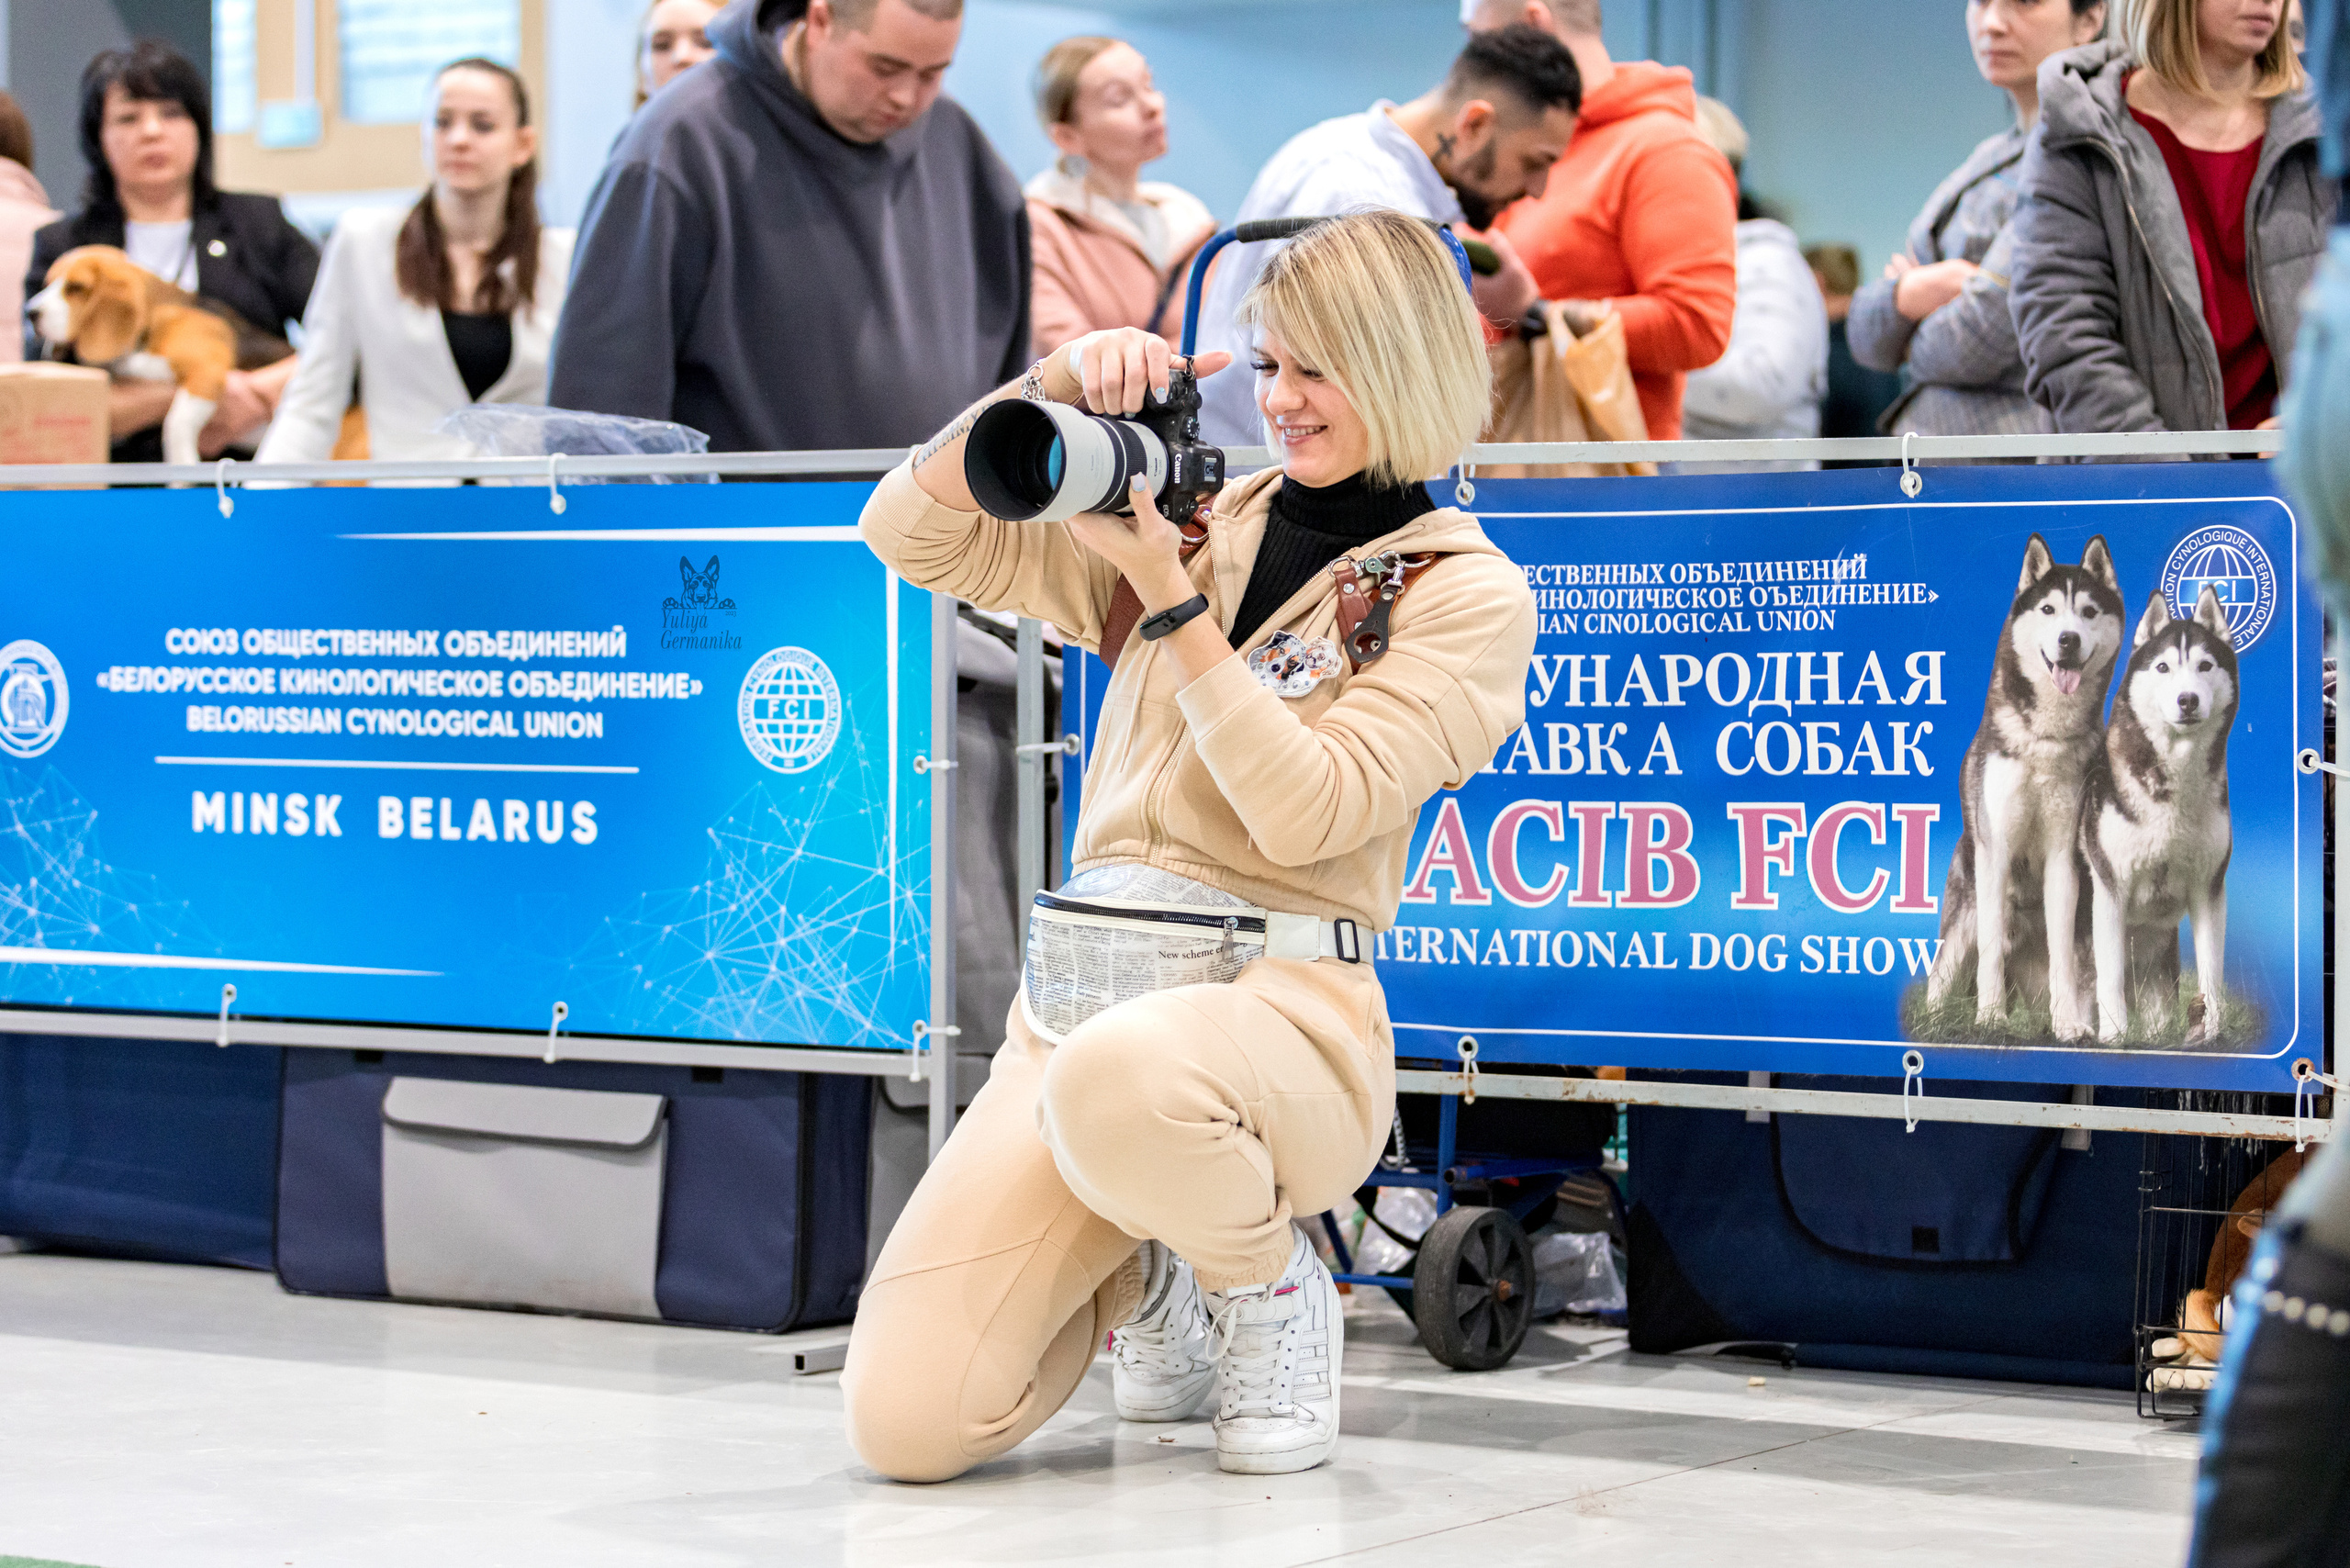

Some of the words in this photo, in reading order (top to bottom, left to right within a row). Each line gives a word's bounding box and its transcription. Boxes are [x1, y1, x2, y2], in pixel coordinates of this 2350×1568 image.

[1174, 453, 1183, 484] Canon
[1162, 504, 1170, 518] EOS
[1520, 564, 1665, 586] ЕСТВЕННЫХ
[1670, 553, 1867, 587] ОБЪЕДИНЕНИЙ
[1531, 588, 1743, 610] ИНОЛОГИЧЕСКОЕ
[1749, 582, 1940, 610] ОЪЕДИНЕНИЕ»
[2172, 531, 2248, 571] CYNOLOGIQUE
[2233, 544, 2272, 647] INTERNATIONALE
[1539, 613, 1579, 634] IAN
[1583, 611, 1751, 634] CINOLOGICAL
[1755, 609, 1837, 632] UNION
[165, 628, 239, 655] СОЮЗ
[241, 628, 441, 659] ОБЩЕСТВЕННЫХ
[443, 624, 627, 661] ОБЪЕДИНЕНИЙ
[96, 666, 276, 694] «БЕЛОРУССКОЕ
[279, 667, 504, 698] КИНОЛОГИЧЕСКОЕ
[507, 670, 703, 701] ОБЪЕДИНЕНИЕ»
[1529, 650, 1947, 717] УНАРОДНАЯ
[186, 705, 341, 734] BELORUSSIAN
[345, 707, 520, 737] CYNOLOGICAL
[523, 710, 603, 738] UNION
[767, 699, 811, 720] FCI
[1478, 720, 1683, 776] АВКА
[1715, 720, 1935, 777] СОБАК
[191, 790, 343, 837] MINSK
[377, 795, 599, 846] BELARUS
[1401, 797, 1701, 909] ACIB
[1727, 801, 1941, 914] FCI
[1158, 950, 1179, 959] New
[1181, 948, 1214, 959] scheme
[1376, 925, 1677, 969] TERNATIONAL
[1688, 933, 1788, 974] DOG
[1800, 935, 1945, 977] SHOW
